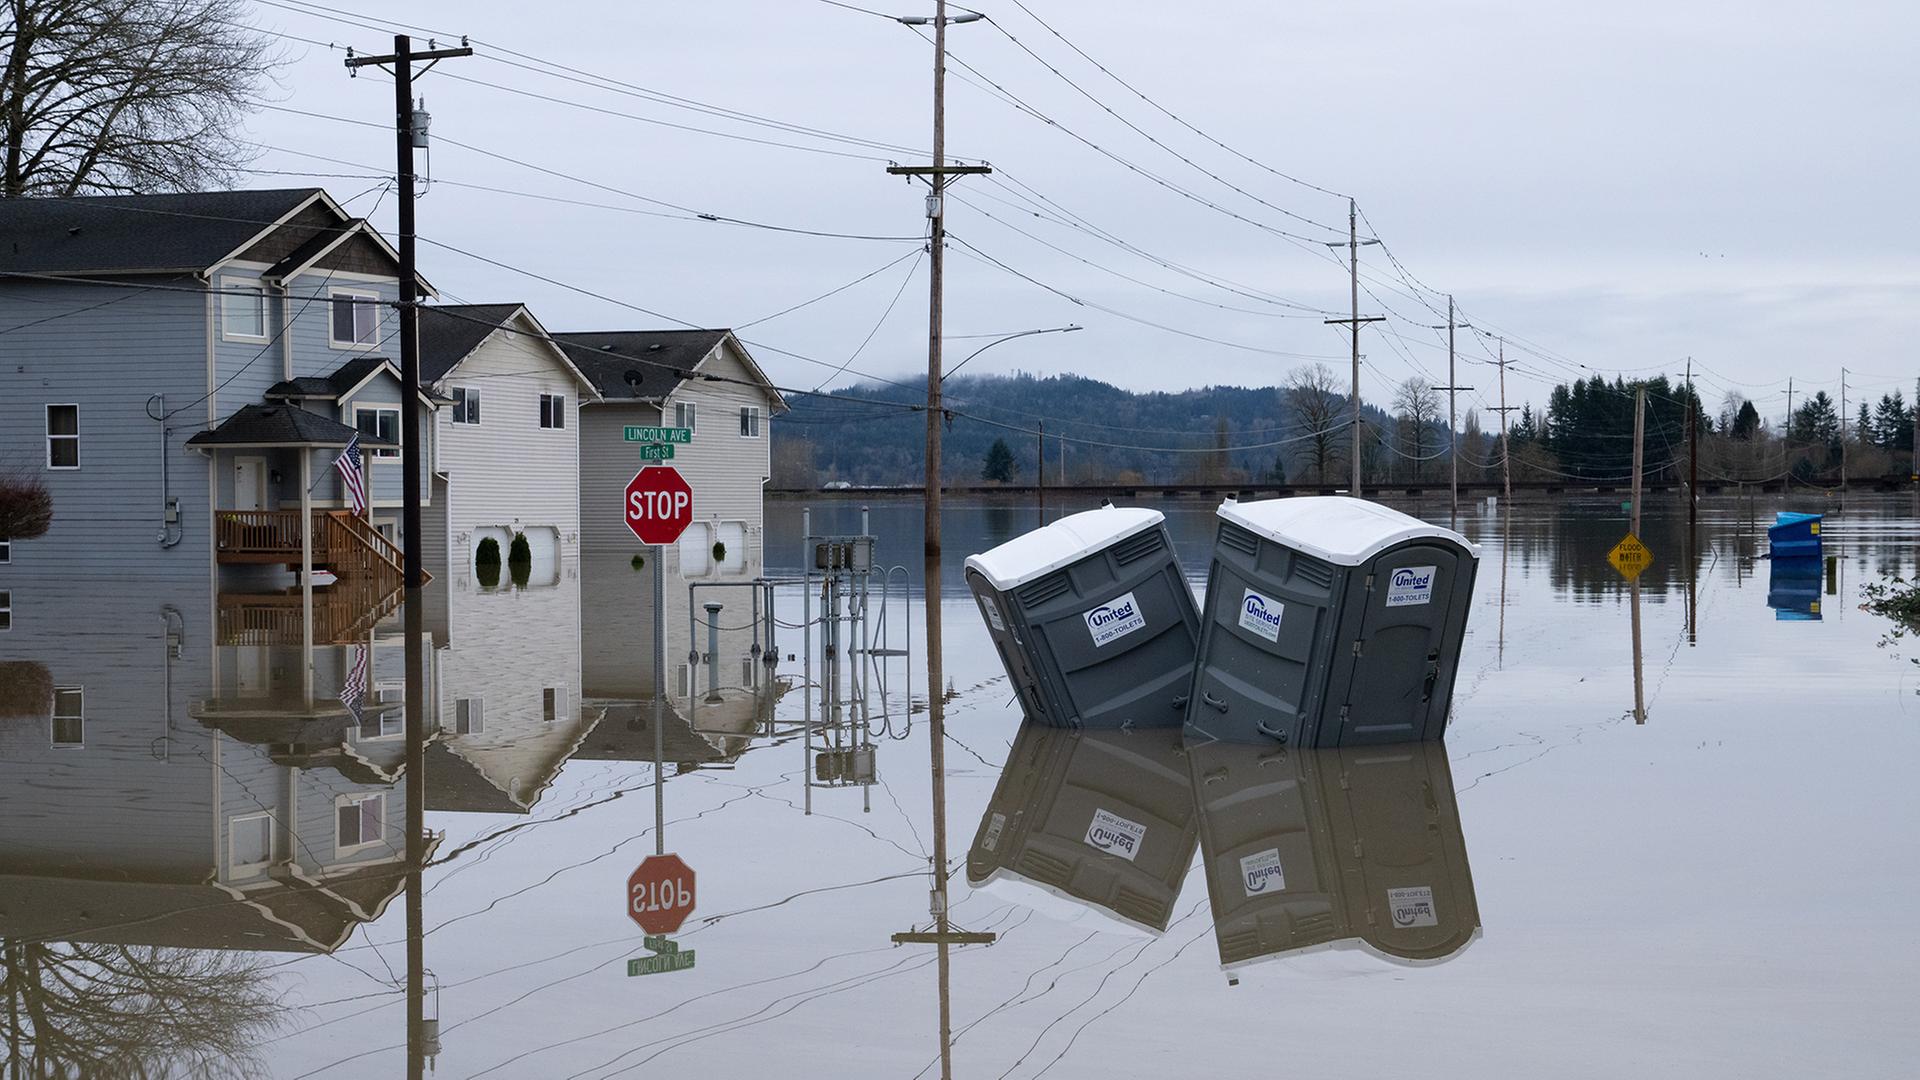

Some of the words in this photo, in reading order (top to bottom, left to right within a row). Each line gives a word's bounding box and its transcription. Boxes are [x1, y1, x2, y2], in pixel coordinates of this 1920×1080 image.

[628, 428, 667, 441] LINCOLN
[670, 430, 687, 441] AVE
[645, 446, 661, 458] First
[661, 446, 669, 458] St
[630, 490, 689, 520] STOP
[1396, 574, 1430, 587] United
[1389, 593, 1430, 602] 1-800-TOILETS
[1092, 602, 1133, 627] United
[1247, 600, 1281, 626] United
[1095, 617, 1143, 643] 1-800-TOILETS
